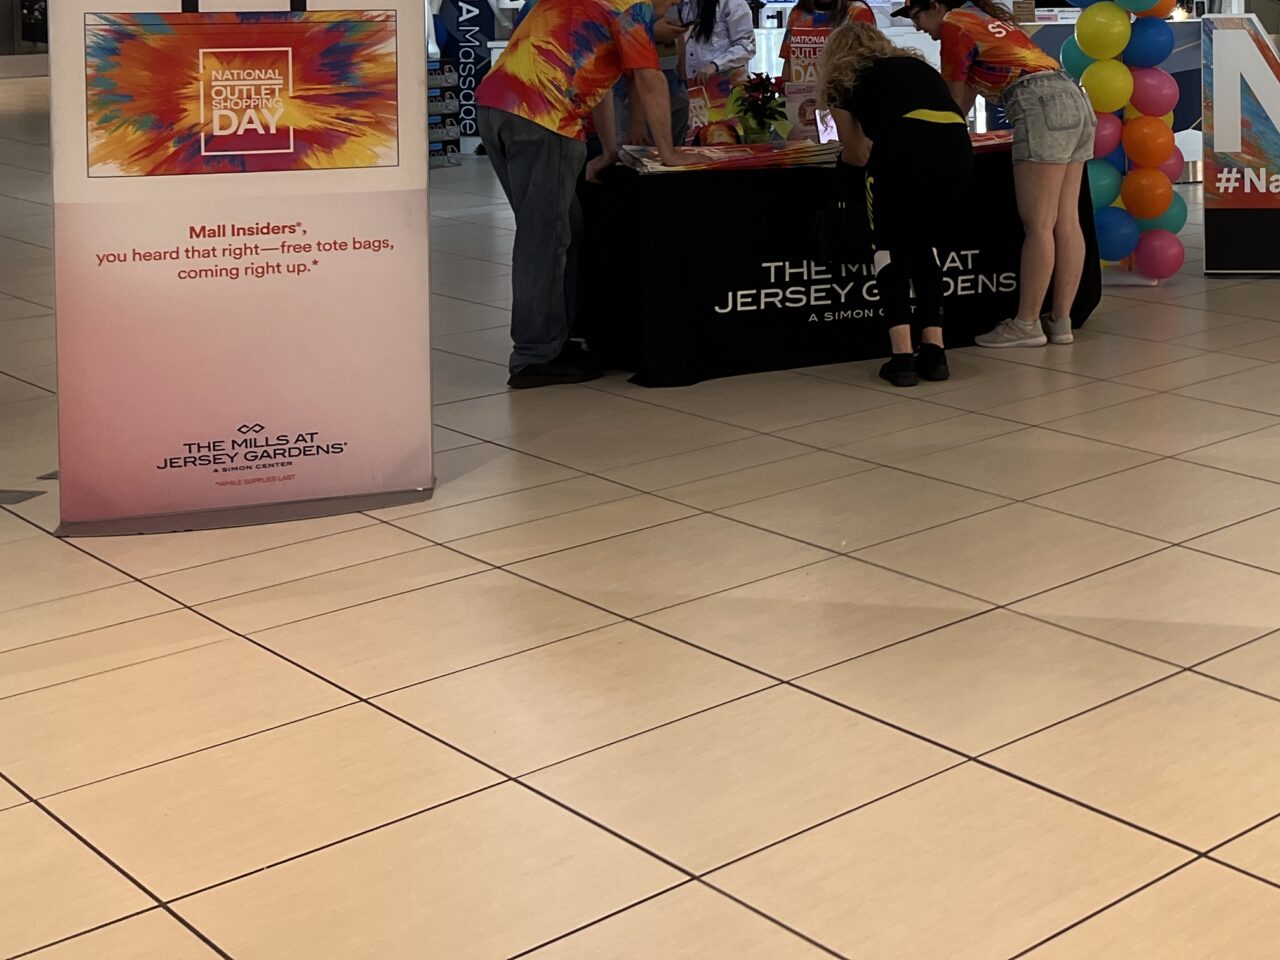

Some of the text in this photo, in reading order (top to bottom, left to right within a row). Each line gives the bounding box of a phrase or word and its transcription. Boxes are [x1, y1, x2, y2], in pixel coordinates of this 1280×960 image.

[790, 36, 828, 44] NATIONA
[211, 69, 283, 81] NATIONAL
[459, 26, 480, 135] Massage
[211, 85, 283, 100] OUTLET
[211, 97, 284, 110] SHOPPING
[212, 108, 284, 136] DAY
[189, 223, 226, 239] Mall
[96, 250, 127, 266] you
[132, 246, 179, 262] heard
[185, 244, 217, 260] that
[316, 239, 348, 253] tote
[353, 236, 394, 252] bags,
[178, 264, 239, 280] coming
[244, 261, 282, 278] right
[762, 261, 832, 283] THE
[943, 250, 979, 271] AT
[714, 282, 854, 313] JERSEY
[824, 309, 873, 321] SIMON
[183, 432, 319, 454] THE MILLS AT
[156, 452, 239, 470] JERSEY
[222, 461, 292, 473] SIMON CENTER
[243, 476, 277, 486] SUPPLIES
[279, 474, 296, 482] LAST
